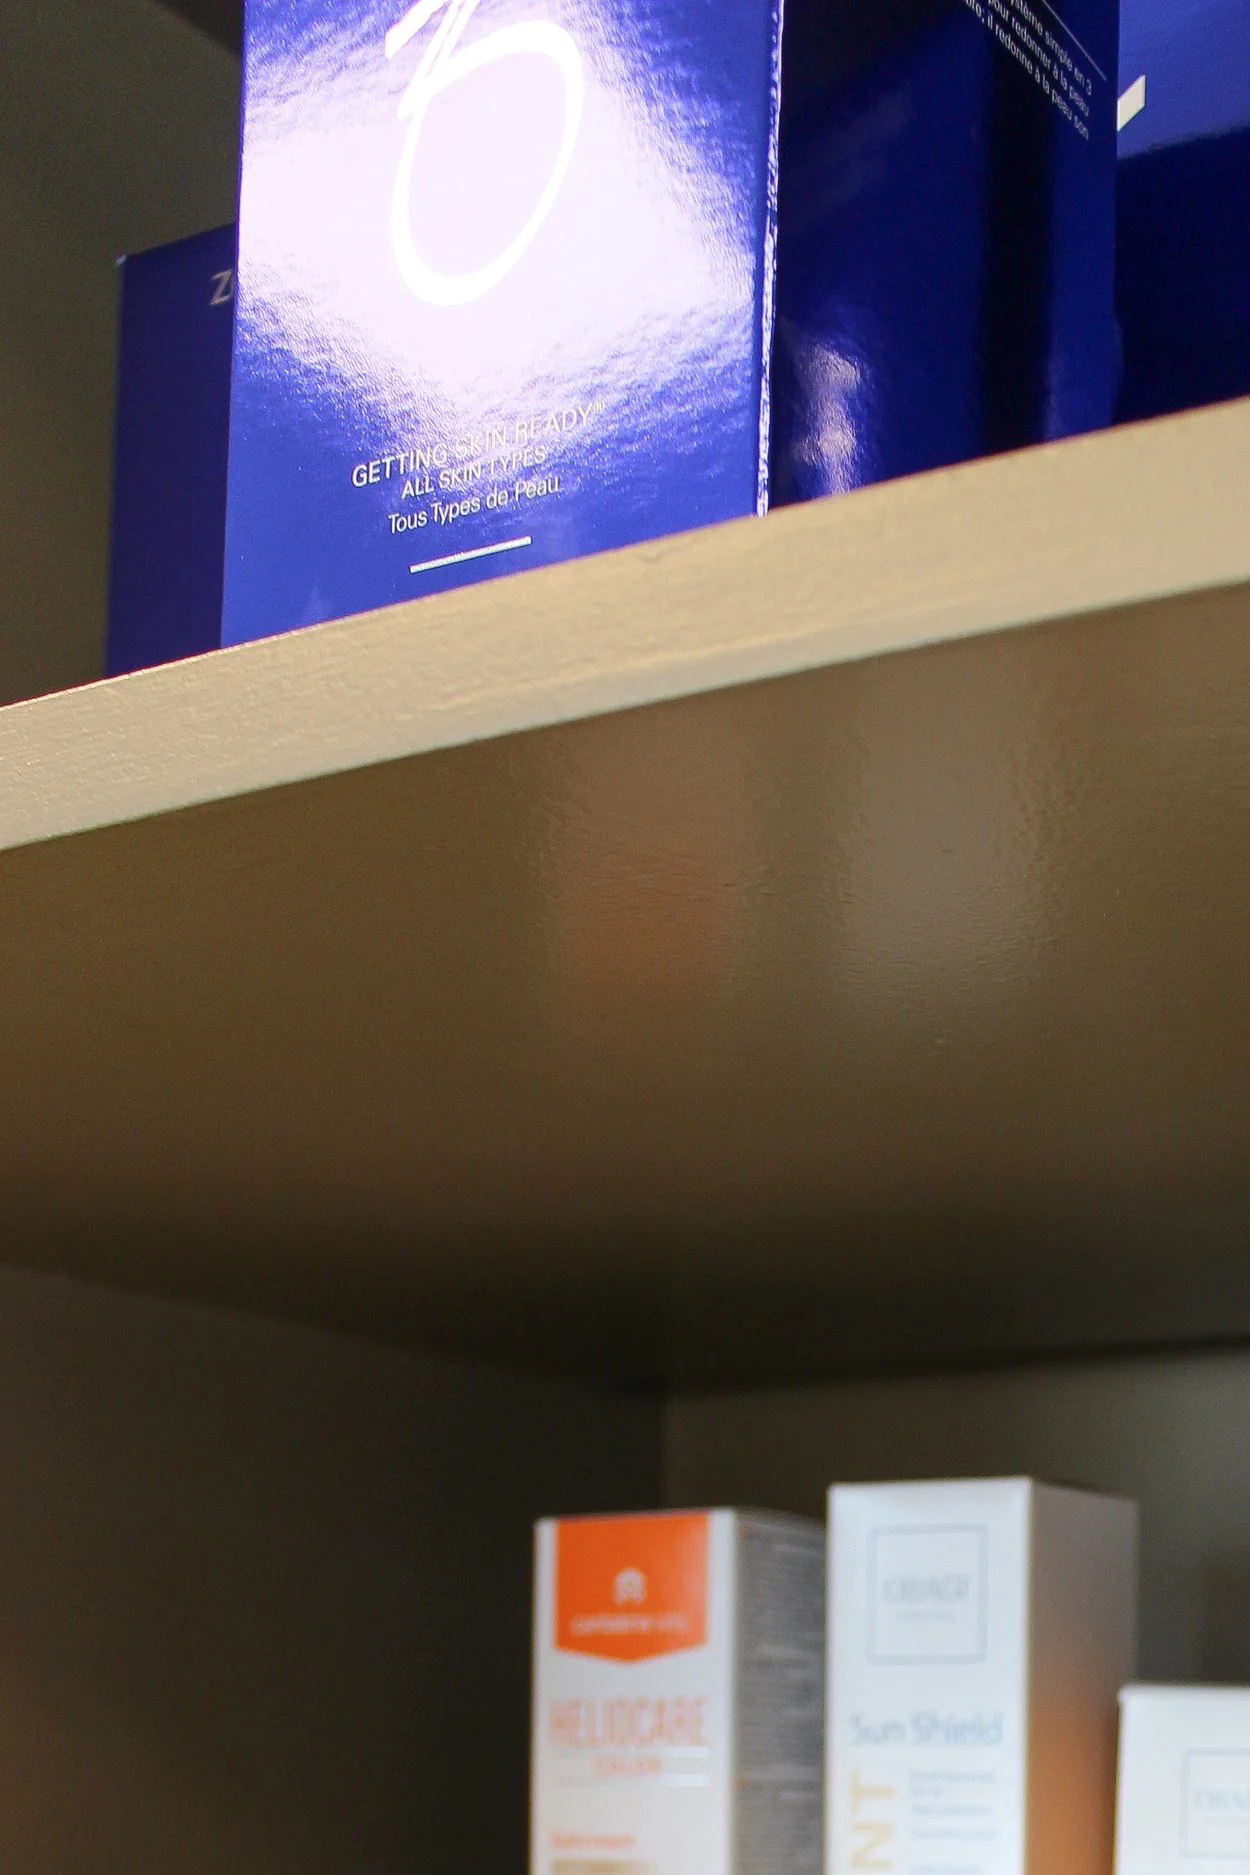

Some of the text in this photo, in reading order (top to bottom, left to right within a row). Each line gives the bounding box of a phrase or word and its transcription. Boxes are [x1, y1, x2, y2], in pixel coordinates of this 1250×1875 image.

[995, 24, 1033, 74] redonne
[1042, 75, 1050, 95] la
[1051, 90, 1072, 120] peau
[1073, 115, 1089, 141] son
[1012, 17, 1051, 70] redonner
[1060, 72, 1068, 91] la
[1069, 87, 1089, 117] peau
[1044, 31, 1073, 72] simple
[1074, 68, 1085, 89] en
[1086, 79, 1092, 96] 3
[210, 268, 233, 305] Z
[352, 447, 448, 489] GETTING
[454, 425, 507, 459] SKIN
[401, 445, 547, 500] ALL SKIN TYPES
[388, 476, 560, 535] Tous Types de Peau
